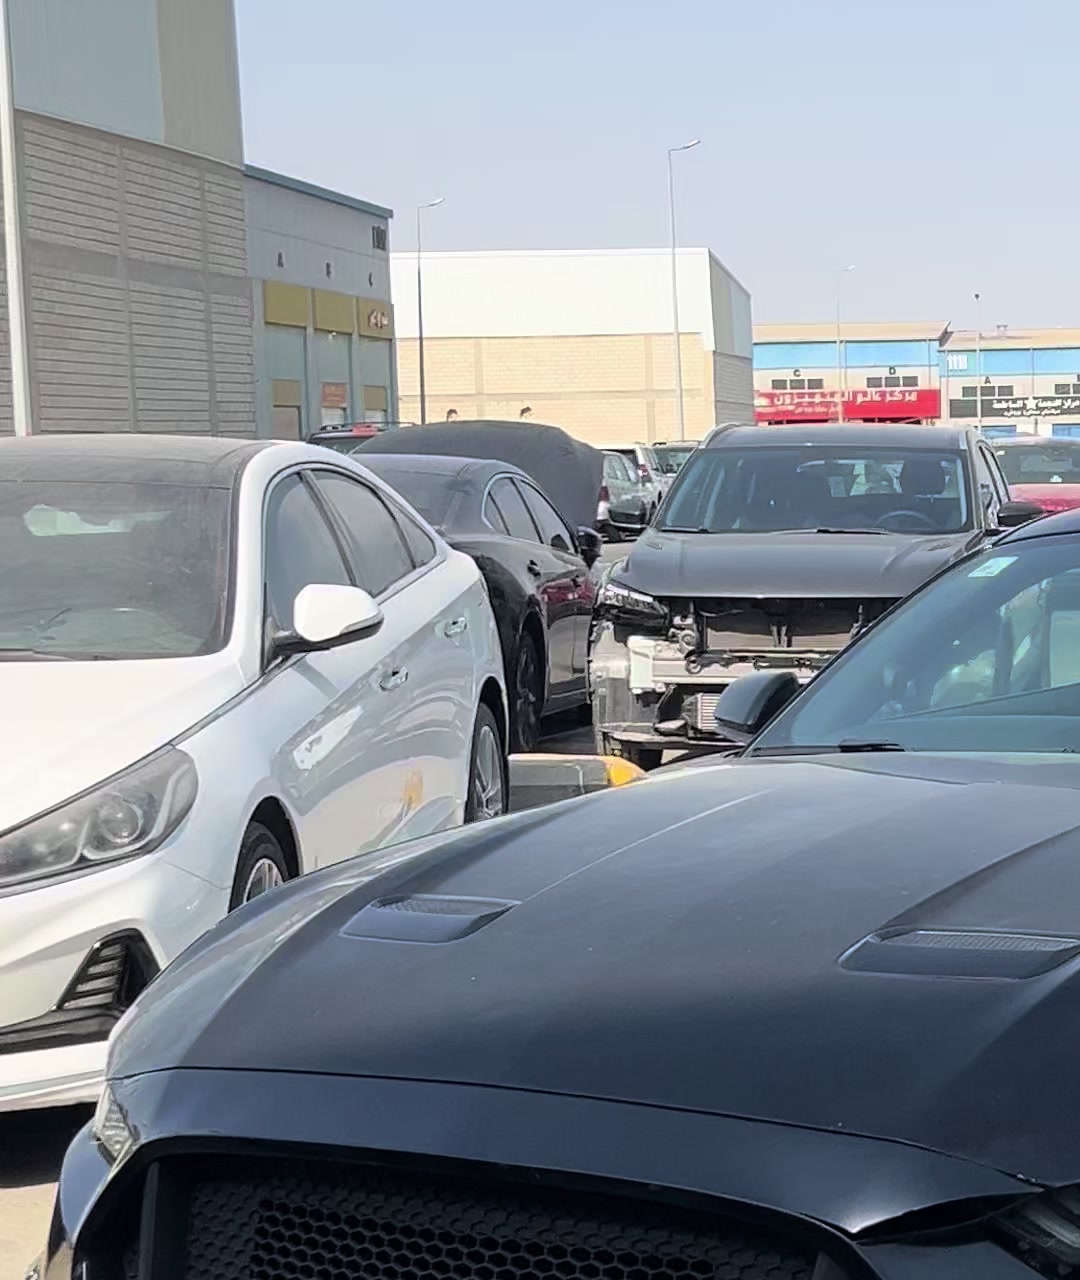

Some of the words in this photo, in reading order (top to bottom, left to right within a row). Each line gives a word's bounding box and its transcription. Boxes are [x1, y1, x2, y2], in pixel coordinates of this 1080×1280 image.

[793, 369, 801, 377] C
[888, 366, 897, 375] D
[984, 376, 992, 384] A
[884, 389, 918, 403] مركز
